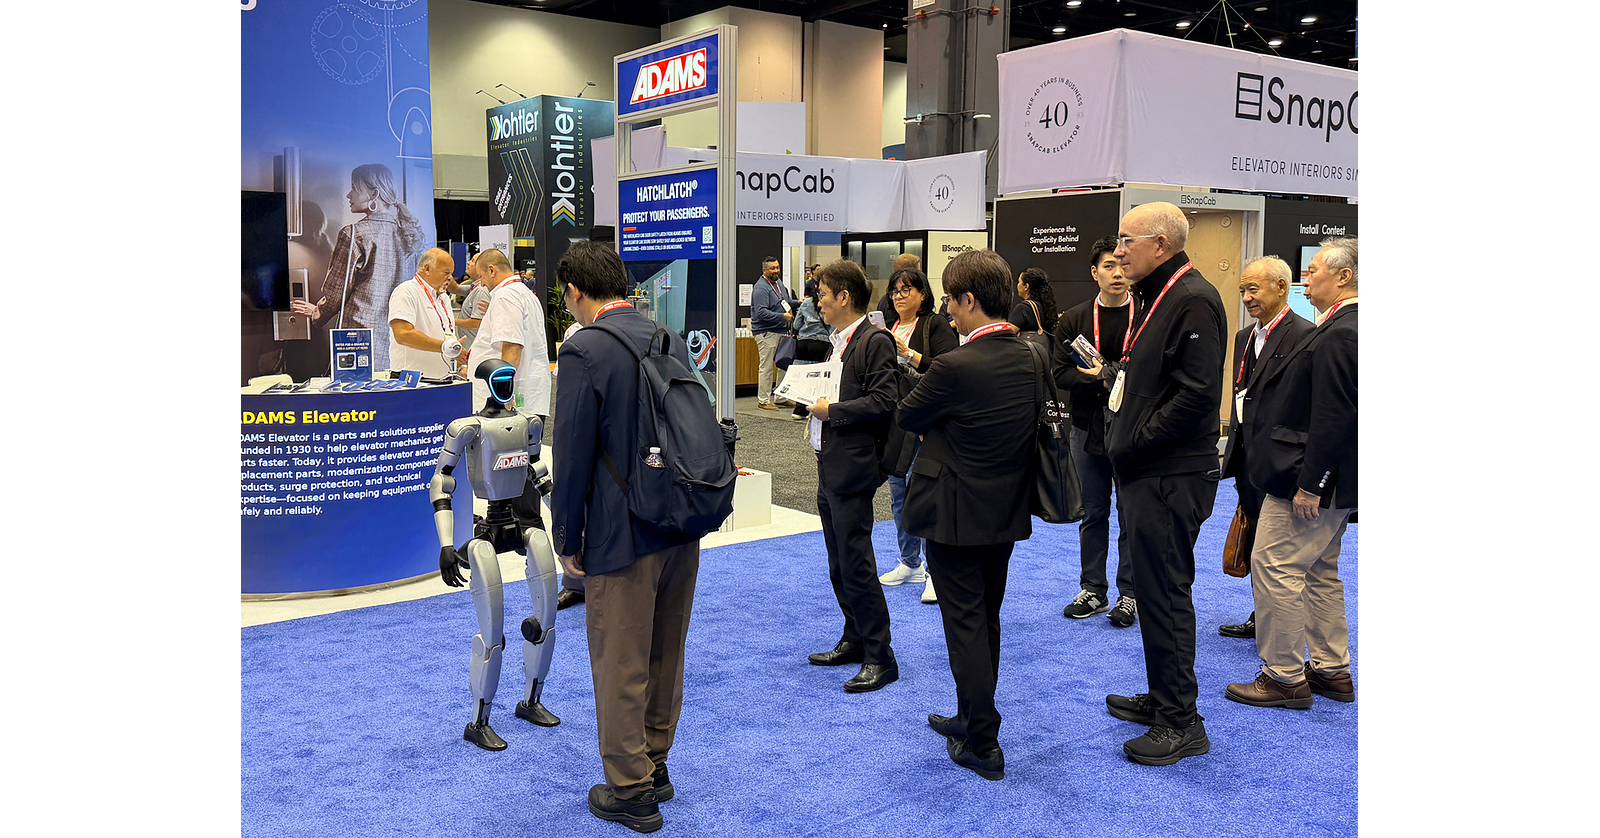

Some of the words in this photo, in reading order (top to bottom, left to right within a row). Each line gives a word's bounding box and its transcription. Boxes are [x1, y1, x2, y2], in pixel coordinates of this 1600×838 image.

[632, 52, 705, 102] ADAMS
[1026, 97, 1034, 116] OVER
[1034, 88, 1040, 96] 40
[1040, 77, 1058, 89] YEARS
[1064, 79, 1083, 106] BUSINESS
[490, 108, 539, 140] Kohtler
[1039, 101, 1068, 129] 40
[1027, 132, 1050, 154] SNAPCAB
[1053, 124, 1080, 153] ELEVATOR
[550, 102, 576, 227] Kohtler
[1232, 156, 1286, 175] ELEVATOR
[1290, 162, 1343, 180] INTERIORS
[636, 180, 698, 202] HATCHLATCH®
[935, 186, 949, 200] 40
[1186, 195, 1217, 207] SnapCab
[623, 212, 648, 224] PROTECT
[650, 210, 666, 222] YOUR
[667, 206, 710, 220] PASSENGERS.
[737, 211, 784, 220] INTERIORS
[787, 213, 834, 222] SIMPLIFIED
[1033, 226, 1065, 235] Experience
[1300, 224, 1319, 235] Install
[1321, 224, 1346, 235] Contest
[1030, 236, 1057, 245] Simplicity
[1044, 244, 1076, 252] Installation
[241, 411, 296, 424] DAMS
[302, 409, 377, 424] Elevator
[268, 433, 310, 442] Elevator
[333, 431, 357, 442] parts
[360, 429, 377, 438] and
[380, 427, 416, 437] solutions
[418, 423, 444, 434] supplier
[273, 446, 283, 454] in
[286, 445, 311, 454] 1930
[327, 444, 348, 453] help
[350, 441, 388, 451] elevator
[390, 436, 431, 448] mechanics
[432, 435, 443, 444] get
[258, 458, 289, 467] faster.
[292, 457, 324, 467] Today,
[327, 456, 334, 465] it
[337, 454, 377, 465] provides
[379, 450, 413, 460] elevator
[415, 447, 428, 456] and
[496, 455, 528, 469] ADAMS
[241, 470, 293, 480] placement
[296, 470, 324, 480] parts,
[327, 464, 393, 476] modernization
[280, 484, 308, 492] surge
[310, 479, 363, 491] protection,
[365, 476, 382, 485] and
[384, 471, 421, 484] technical
[343, 489, 379, 499] keeping
[382, 483, 425, 496] equipment
[264, 506, 282, 515] and
[285, 505, 323, 515] reliably.
